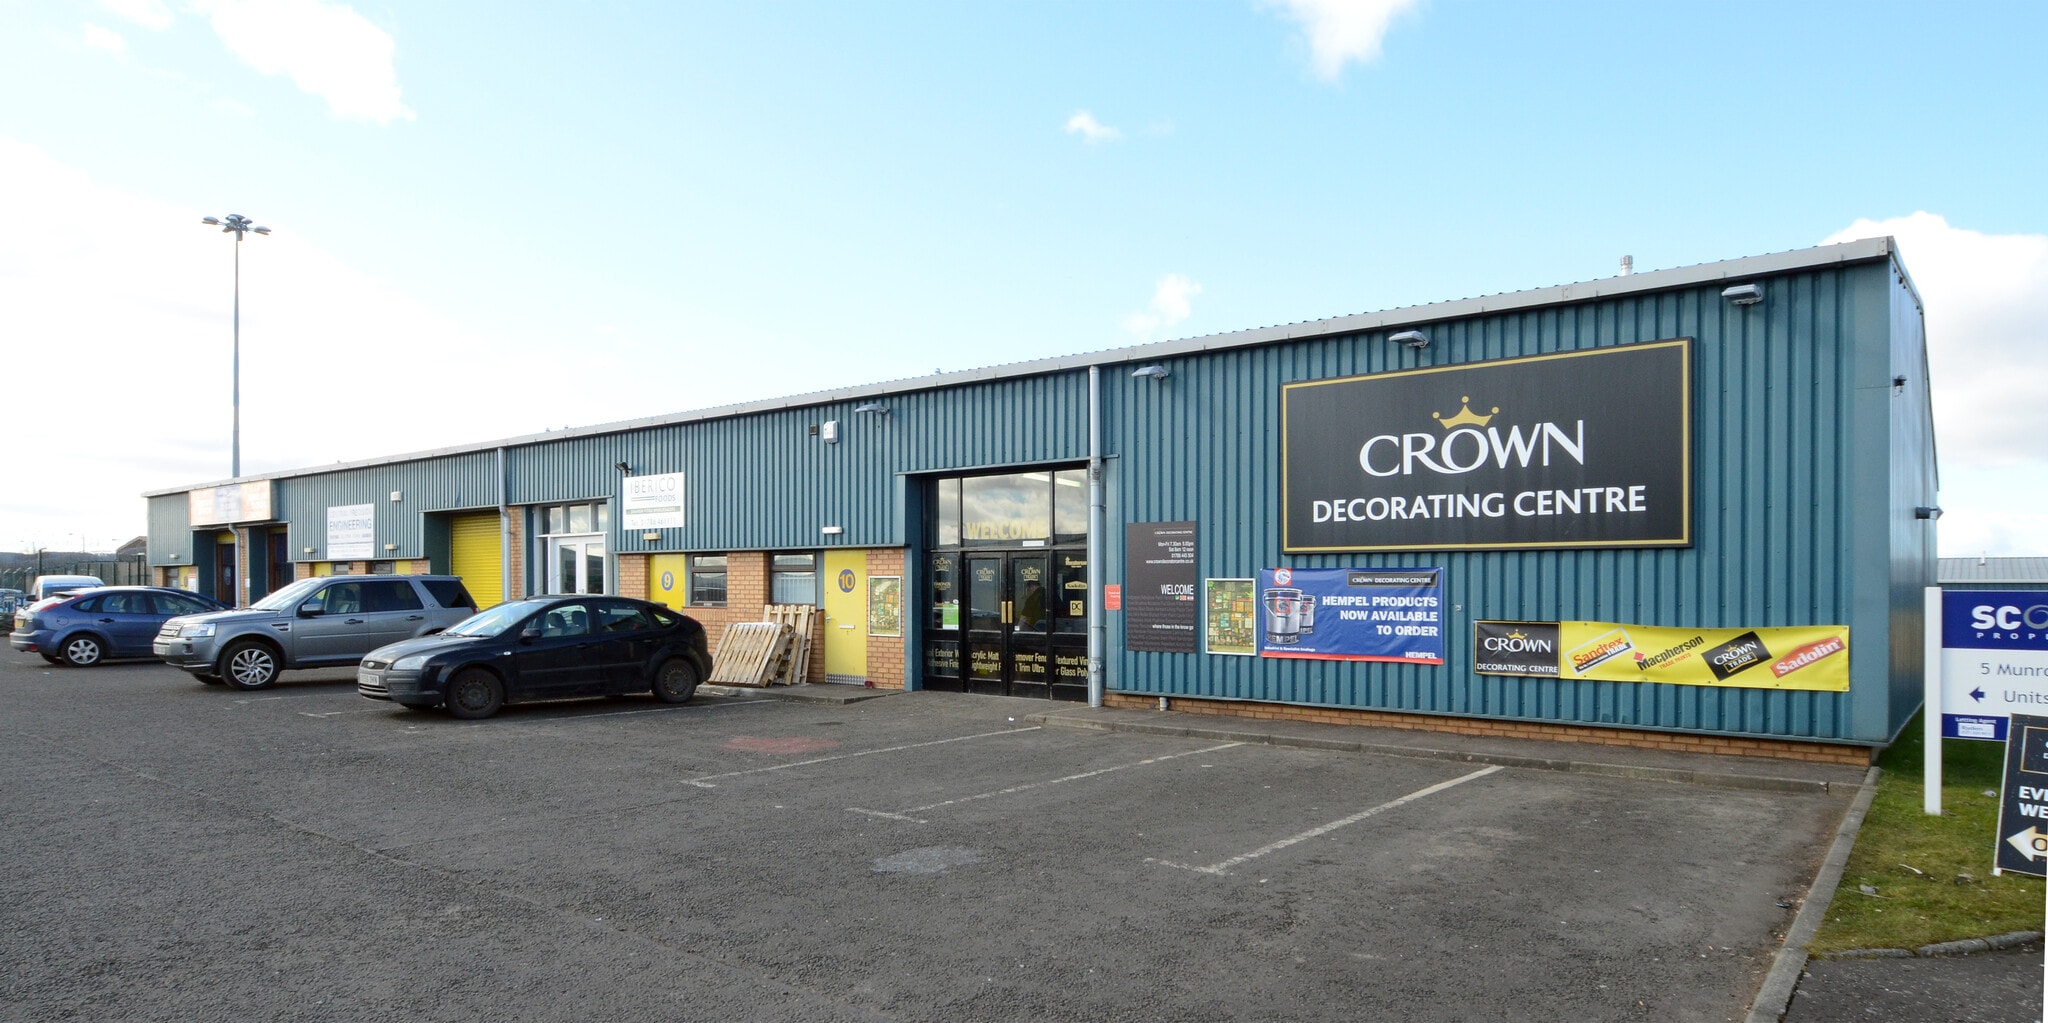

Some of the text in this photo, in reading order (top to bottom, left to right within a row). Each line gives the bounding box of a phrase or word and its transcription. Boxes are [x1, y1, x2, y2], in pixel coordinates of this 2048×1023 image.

[1359, 419, 1584, 477] CROWN
[630, 477, 676, 495] IBERICO
[1312, 485, 1646, 523] DECORATING CENTRE
[329, 518, 372, 531] ENGINEERING
[965, 520, 1048, 539] WELCOME
[664, 574, 671, 588] 9
[840, 573, 854, 589] 10
[1160, 584, 1194, 594] WELCOME
[1322, 596, 1438, 607] HEMPEL PRODUCTS
[1340, 611, 1438, 622] NOW AVAILABLE
[1376, 625, 1438, 636] TO ORDER
[1484, 637, 1551, 653] CROWN
[935, 648, 953, 658] Exterior
[971, 650, 999, 661] crylic Matt
[1015, 654, 1034, 662] emover
[1573, 637, 1623, 667] Sandtex
[1636, 635, 1704, 671] Macpherson
[1714, 641, 1758, 665] CROWN
[1776, 640, 1840, 675] Sadolin
[971, 660, 998, 672] ightweight
[1019, 662, 1030, 672] Trim
[1032, 663, 1045, 673] Ultra
[1477, 663, 1559, 673] DECORATING CENTRE
[1728, 655, 1752, 668] TRADE
[1060, 666, 1076, 677] Glass
[1077, 667, 1088, 679] Poly
[1981, 663, 1990, 675] 5
